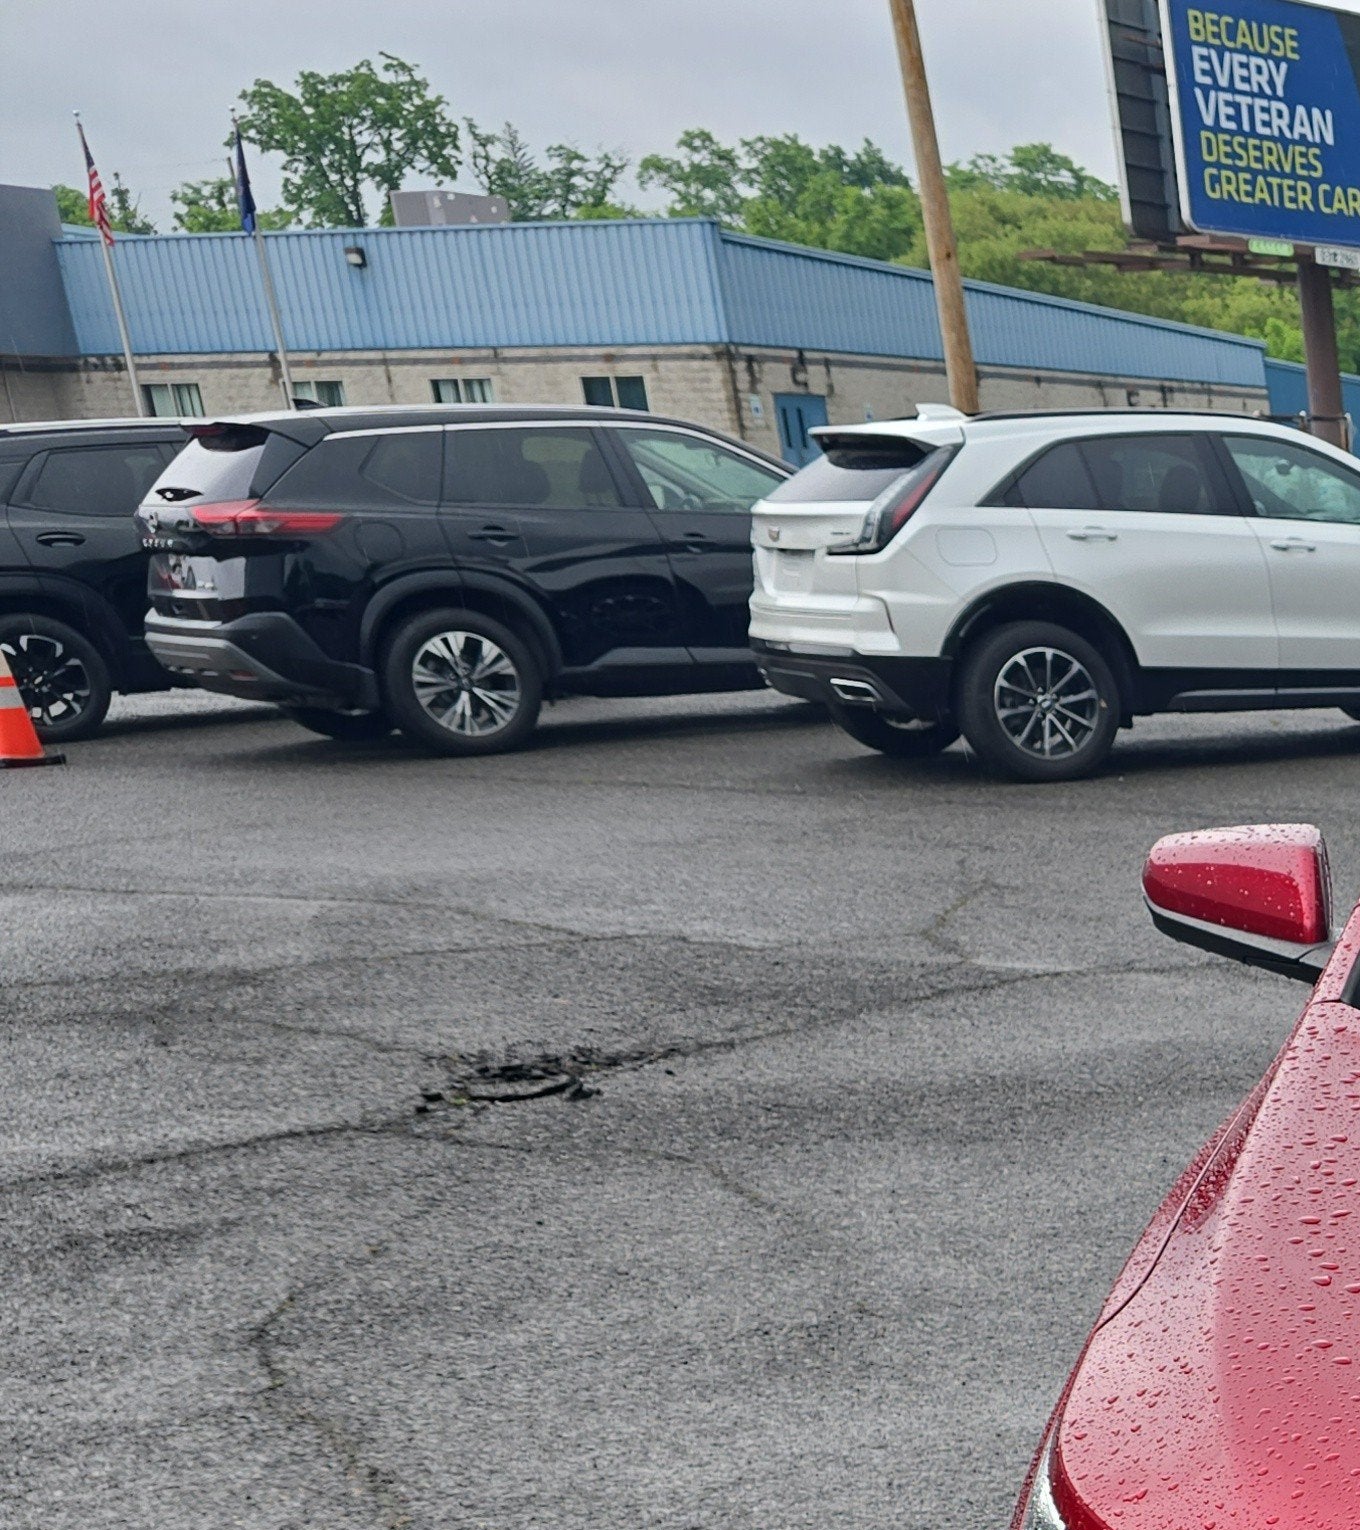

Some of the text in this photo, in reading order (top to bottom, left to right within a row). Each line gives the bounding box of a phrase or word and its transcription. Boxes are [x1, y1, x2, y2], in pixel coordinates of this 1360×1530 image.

[1187, 8, 1299, 60] BECAUSE
[1191, 45, 1288, 97] EVERY
[1194, 87, 1334, 146] VETERAN
[1200, 130, 1323, 178] DESERVES
[1203, 167, 1315, 212] GREATER
